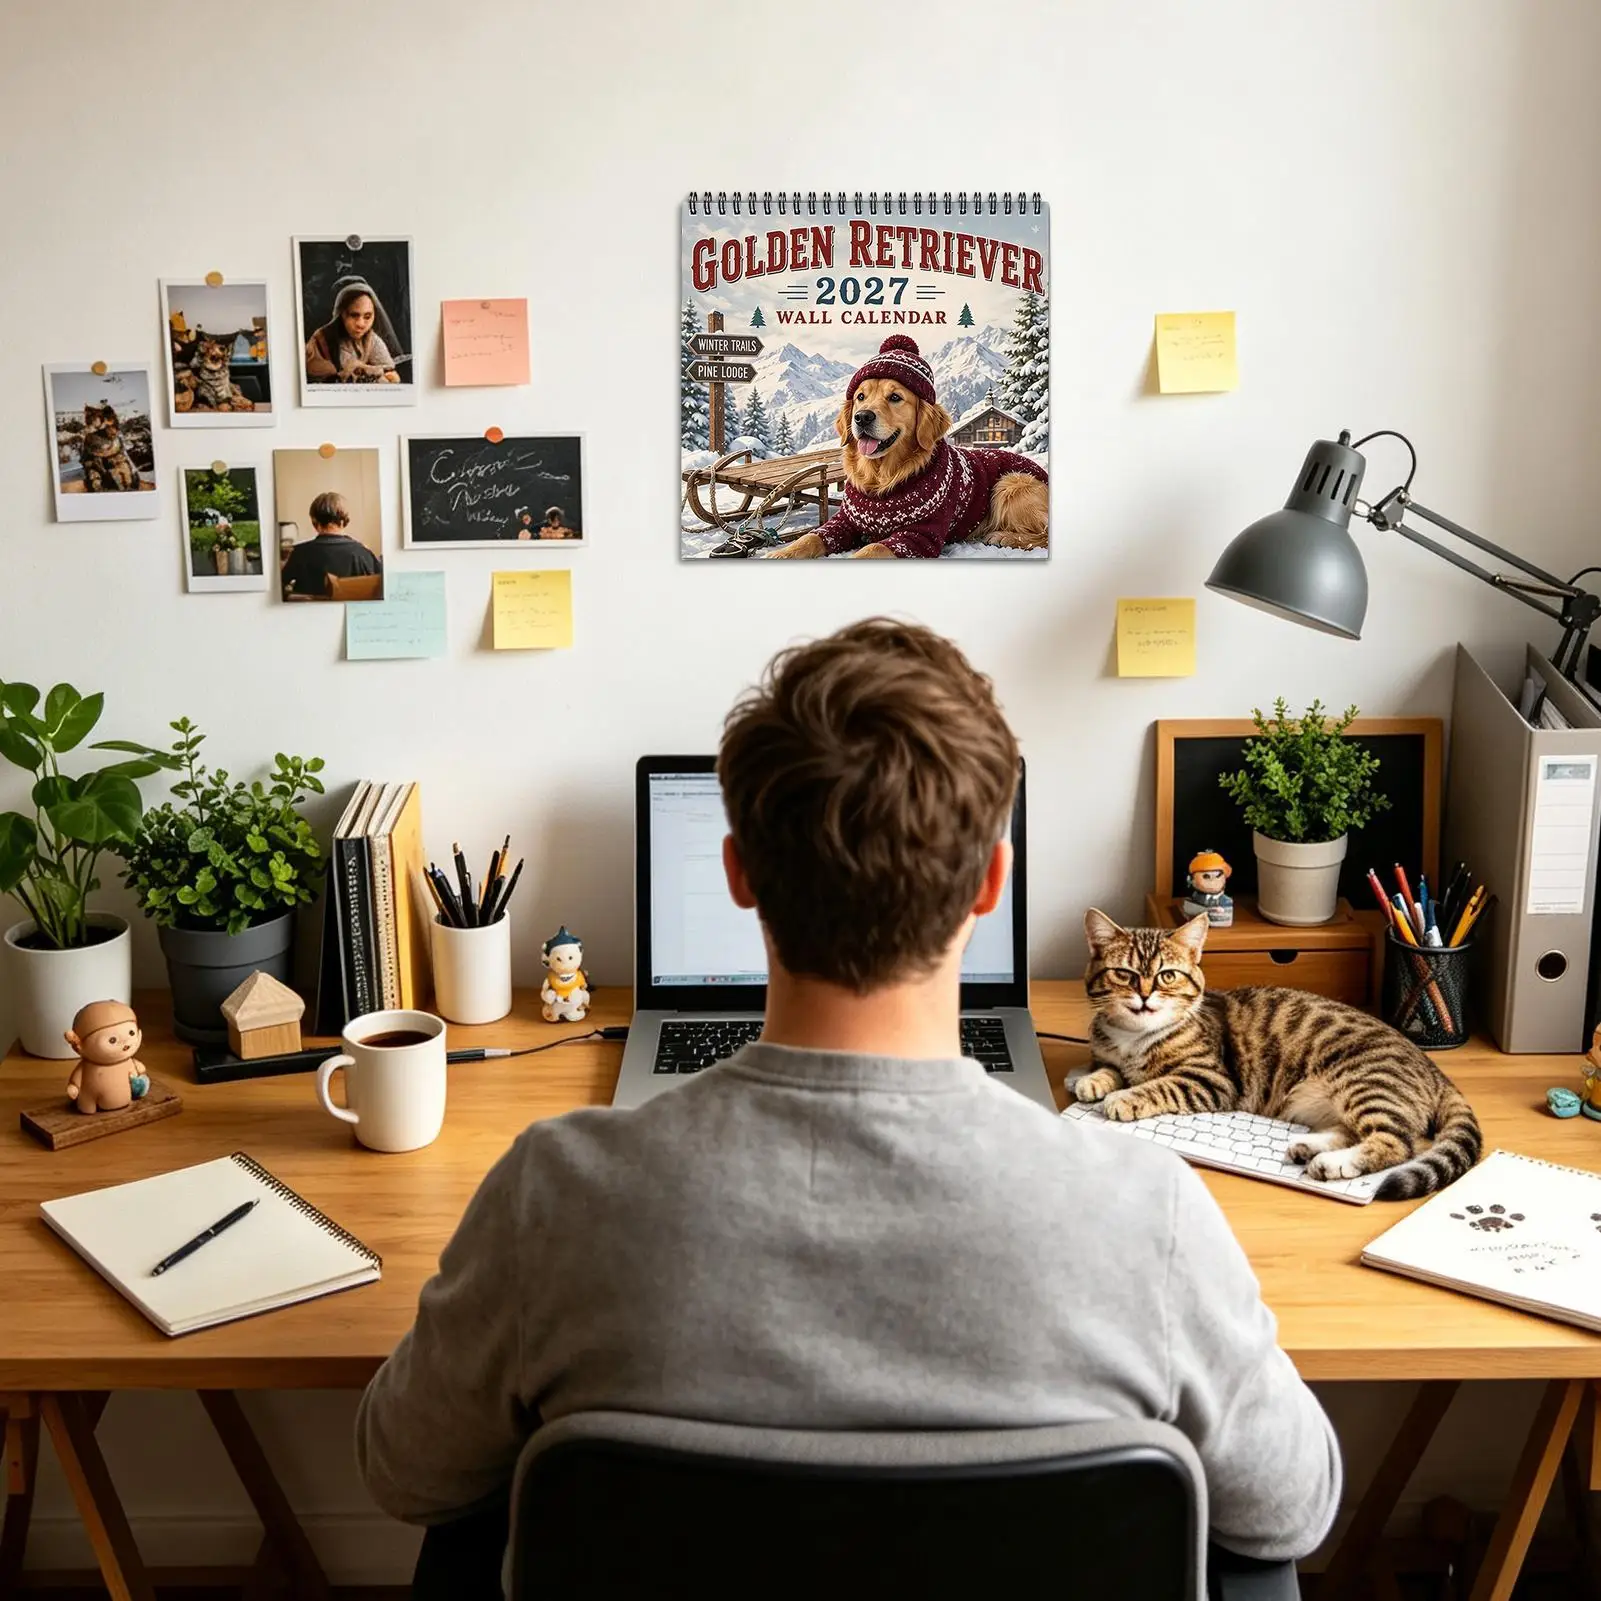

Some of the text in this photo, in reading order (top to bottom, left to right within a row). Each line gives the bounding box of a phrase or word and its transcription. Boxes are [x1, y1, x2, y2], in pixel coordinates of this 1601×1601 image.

[691, 220, 1045, 296] GOLDEN RETRIEVER
[816, 277, 910, 305] 2027
[776, 310, 947, 325] WALL CALENDAR
[697, 338, 757, 353] WINTER TRAILS
[697, 365, 749, 379] PINE LODGE
